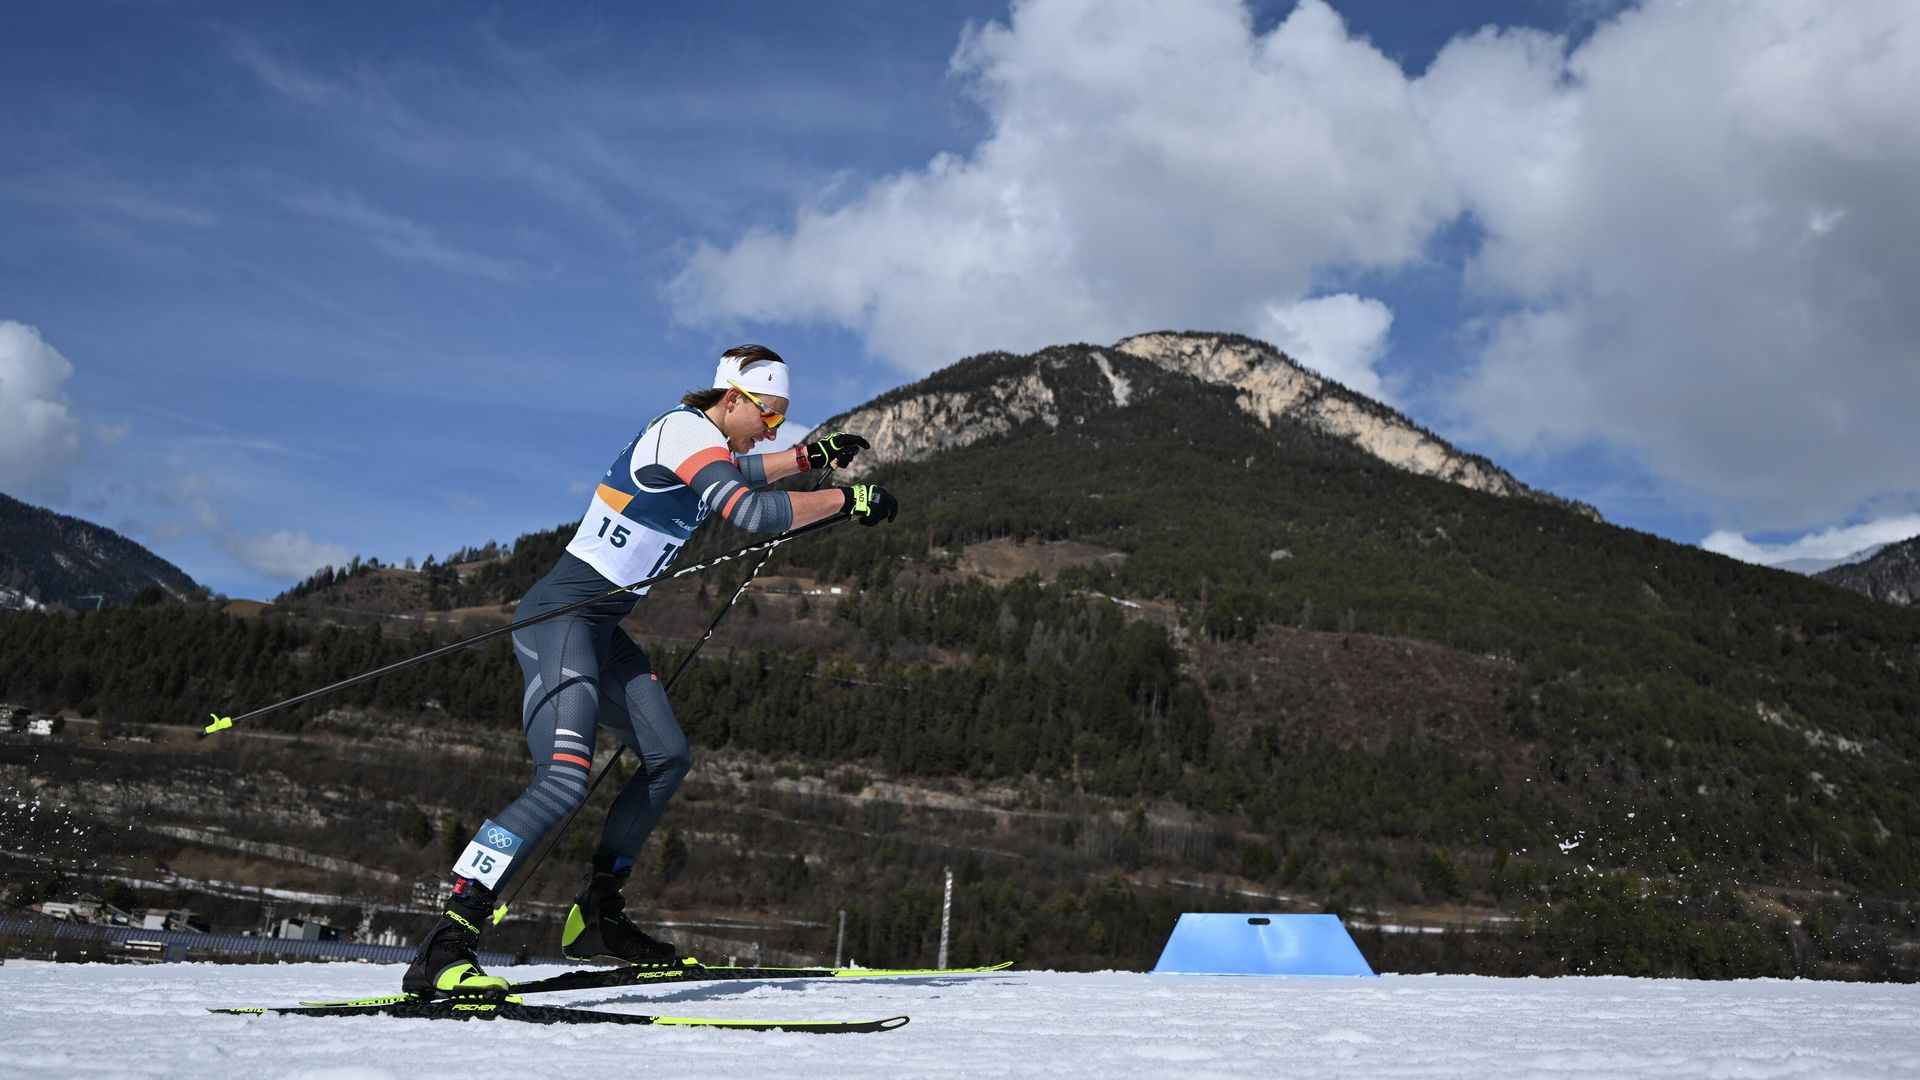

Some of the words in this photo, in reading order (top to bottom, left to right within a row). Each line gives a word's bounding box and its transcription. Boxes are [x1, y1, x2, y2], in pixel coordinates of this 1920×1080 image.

[598, 516, 631, 548] 15
[471, 850, 496, 874] 15
[636, 970, 683, 979] FISCHER
